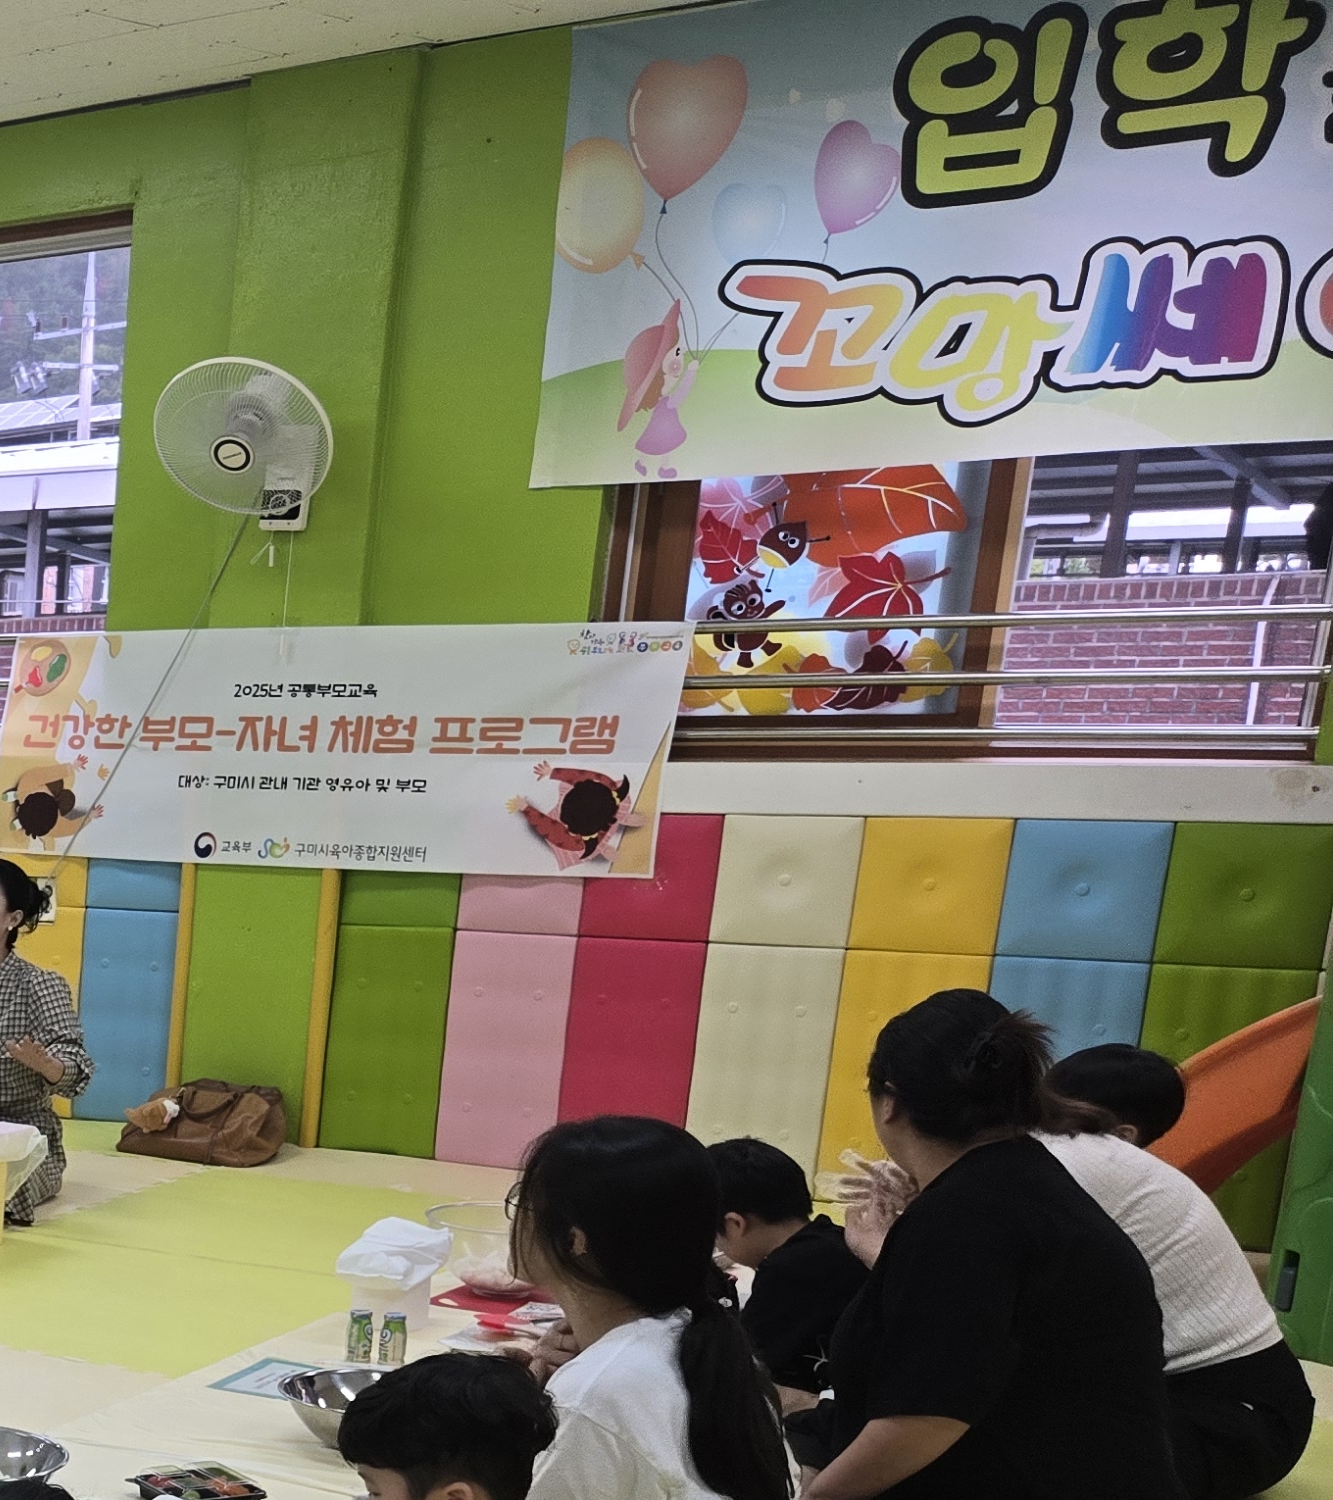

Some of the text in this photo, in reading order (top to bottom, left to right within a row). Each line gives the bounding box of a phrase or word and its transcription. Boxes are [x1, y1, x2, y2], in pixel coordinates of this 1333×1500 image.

[894, 0, 1333, 209] 입학
[234, 683, 379, 698] 2025년 공통부모교육
[23, 713, 620, 755] 건강한 부모-자녀 체험 프로그램
[178, 775, 427, 794] 대상: 구미시 관내 기관 영유아 및 부모
[221, 840, 252, 853] 교육부
[294, 843, 428, 863] 구미시육아종합지원센터
